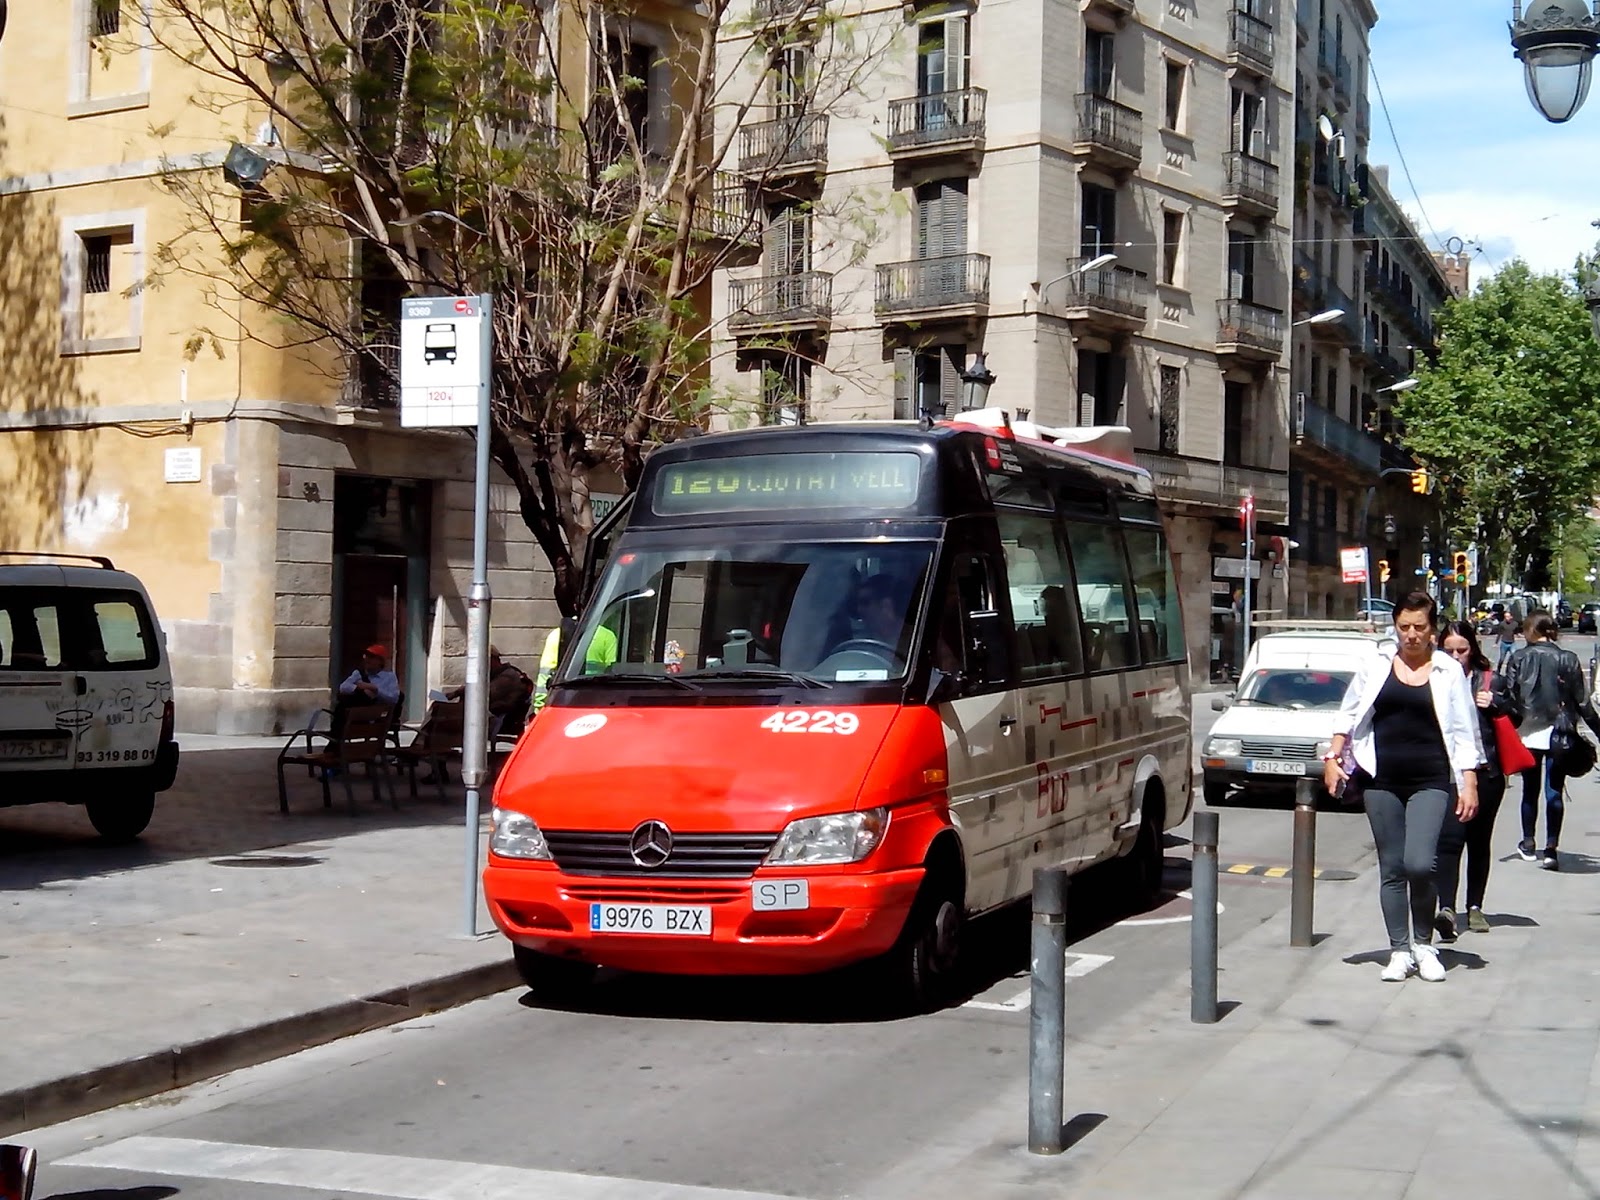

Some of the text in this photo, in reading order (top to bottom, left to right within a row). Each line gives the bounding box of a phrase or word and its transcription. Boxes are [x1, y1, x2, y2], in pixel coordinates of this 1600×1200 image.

[429, 391, 447, 401] 120
[671, 471, 740, 495] 120
[760, 710, 860, 735] 4229
[77, 748, 156, 763] 93 319 88 01
[1255, 761, 1279, 773] 4612
[759, 883, 801, 907] SP
[605, 907, 704, 931] 9976 BZX
